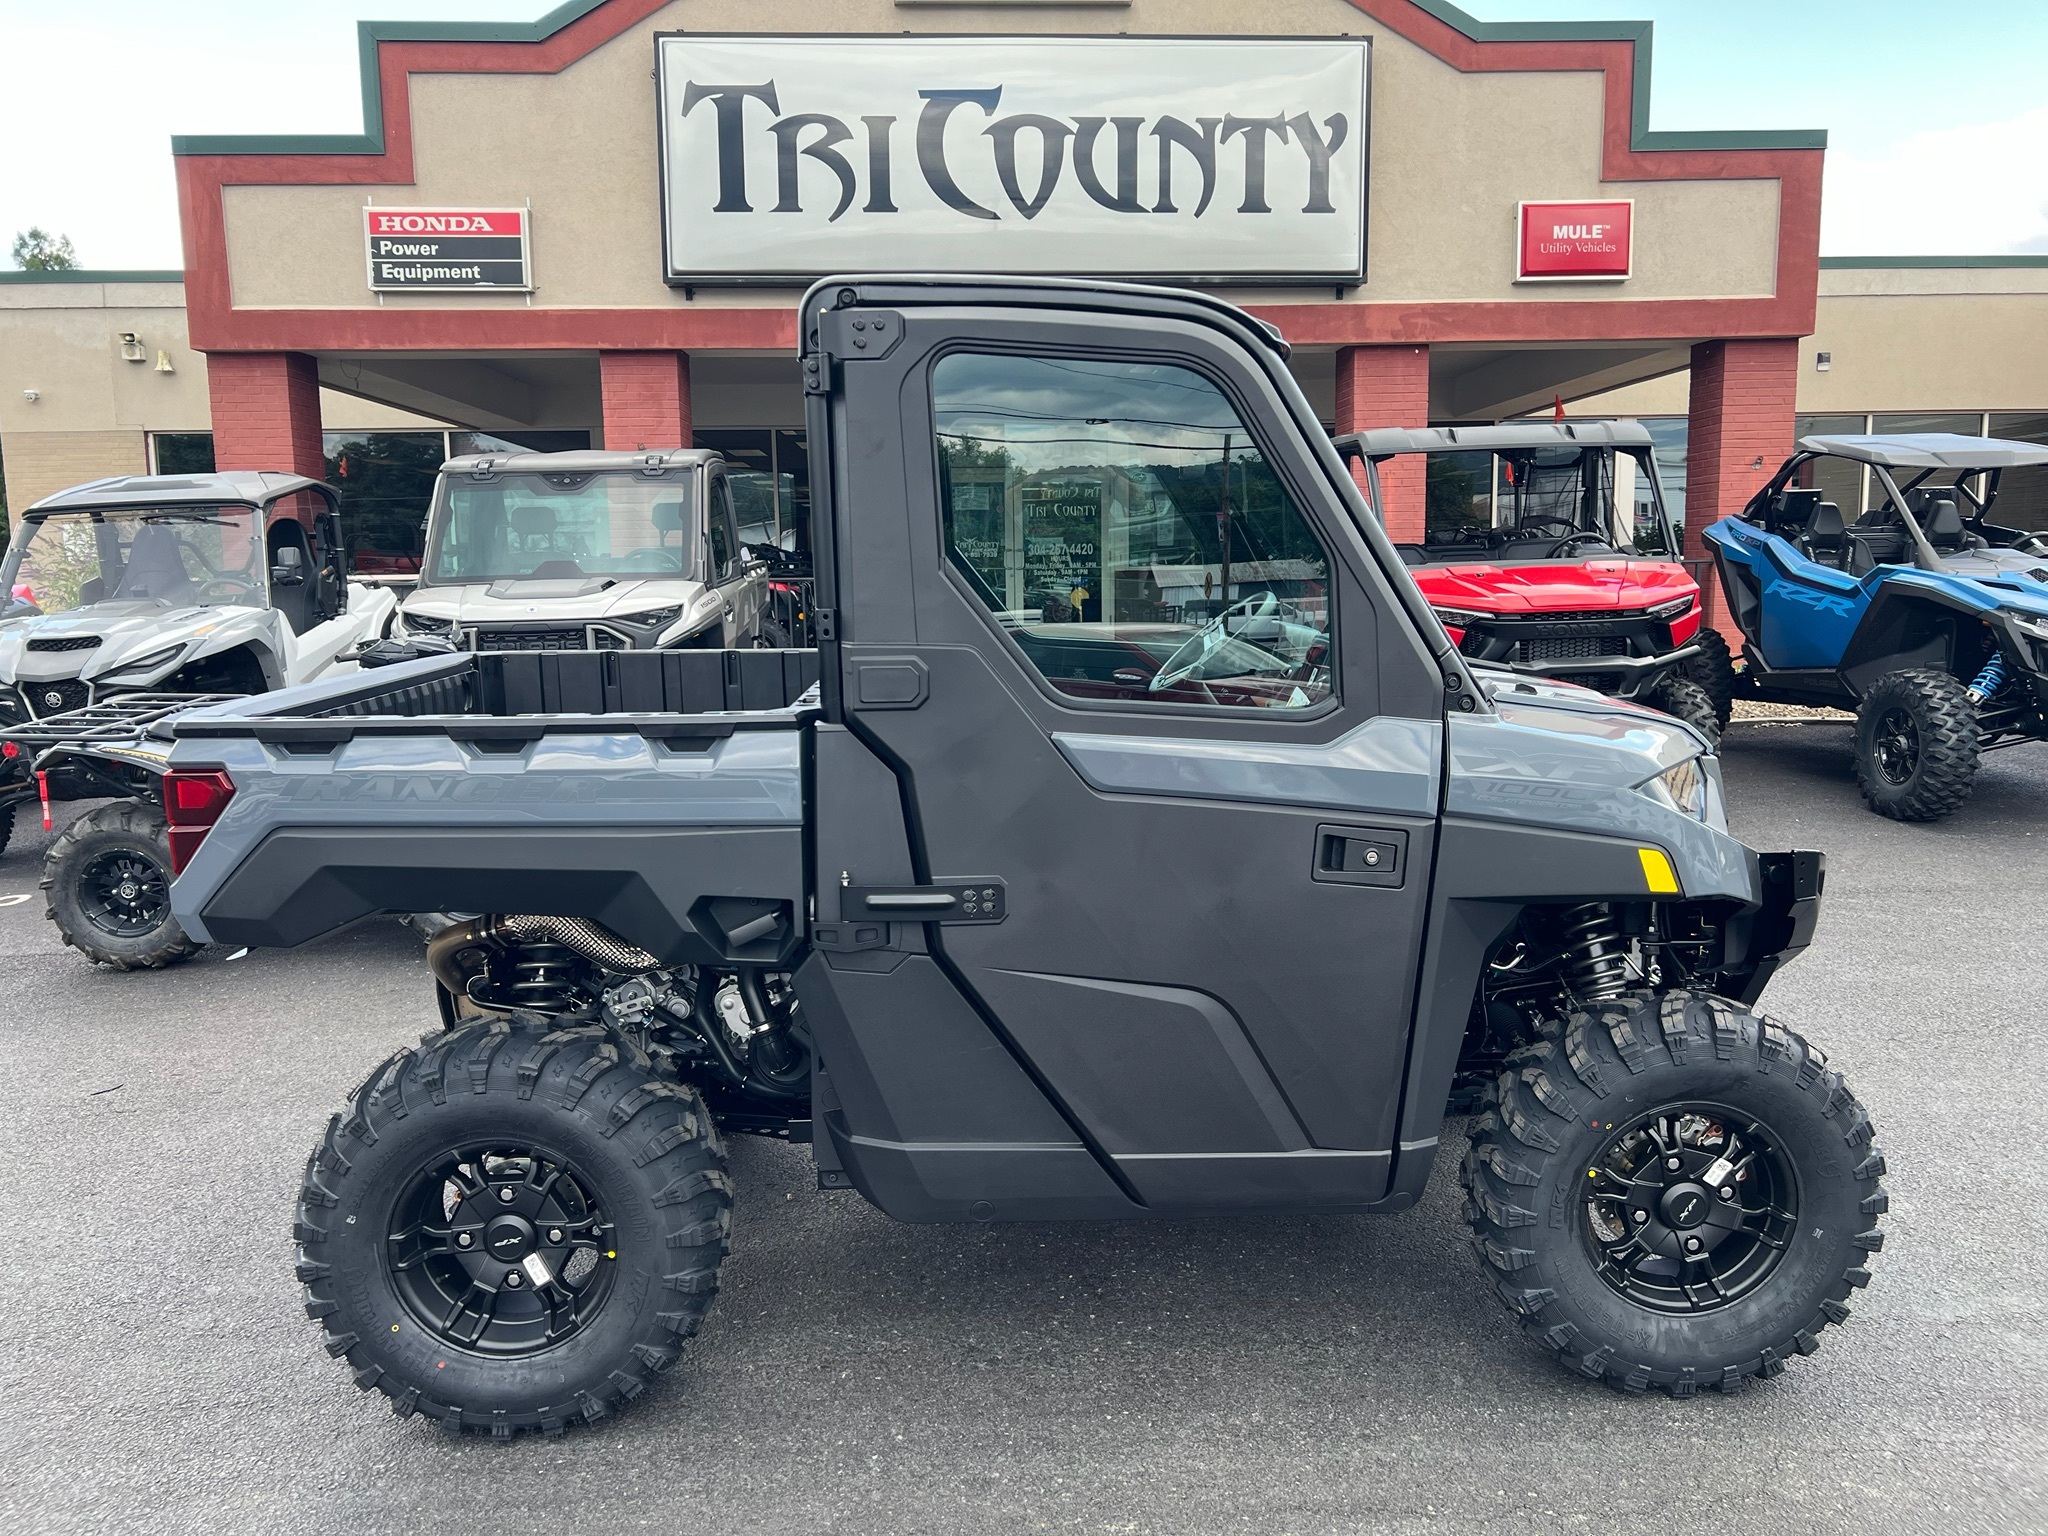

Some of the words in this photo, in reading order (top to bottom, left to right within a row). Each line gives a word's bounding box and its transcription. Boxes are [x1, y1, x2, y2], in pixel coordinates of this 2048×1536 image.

[378, 216, 494, 232] HONDA
[379, 240, 439, 256] Power
[1540, 242, 1573, 256] Utility
[1575, 241, 1617, 253] Vehicles
[381, 263, 481, 282] Equipment
[1764, 578, 1856, 618] RZR
[1535, 622, 1617, 637] HONDA
[1803, 677, 1839, 689] POLARIS
[292, 775, 607, 804] RANGER
[1680, 1198, 1697, 1222] XP
[494, 1236, 523, 1247] XP
